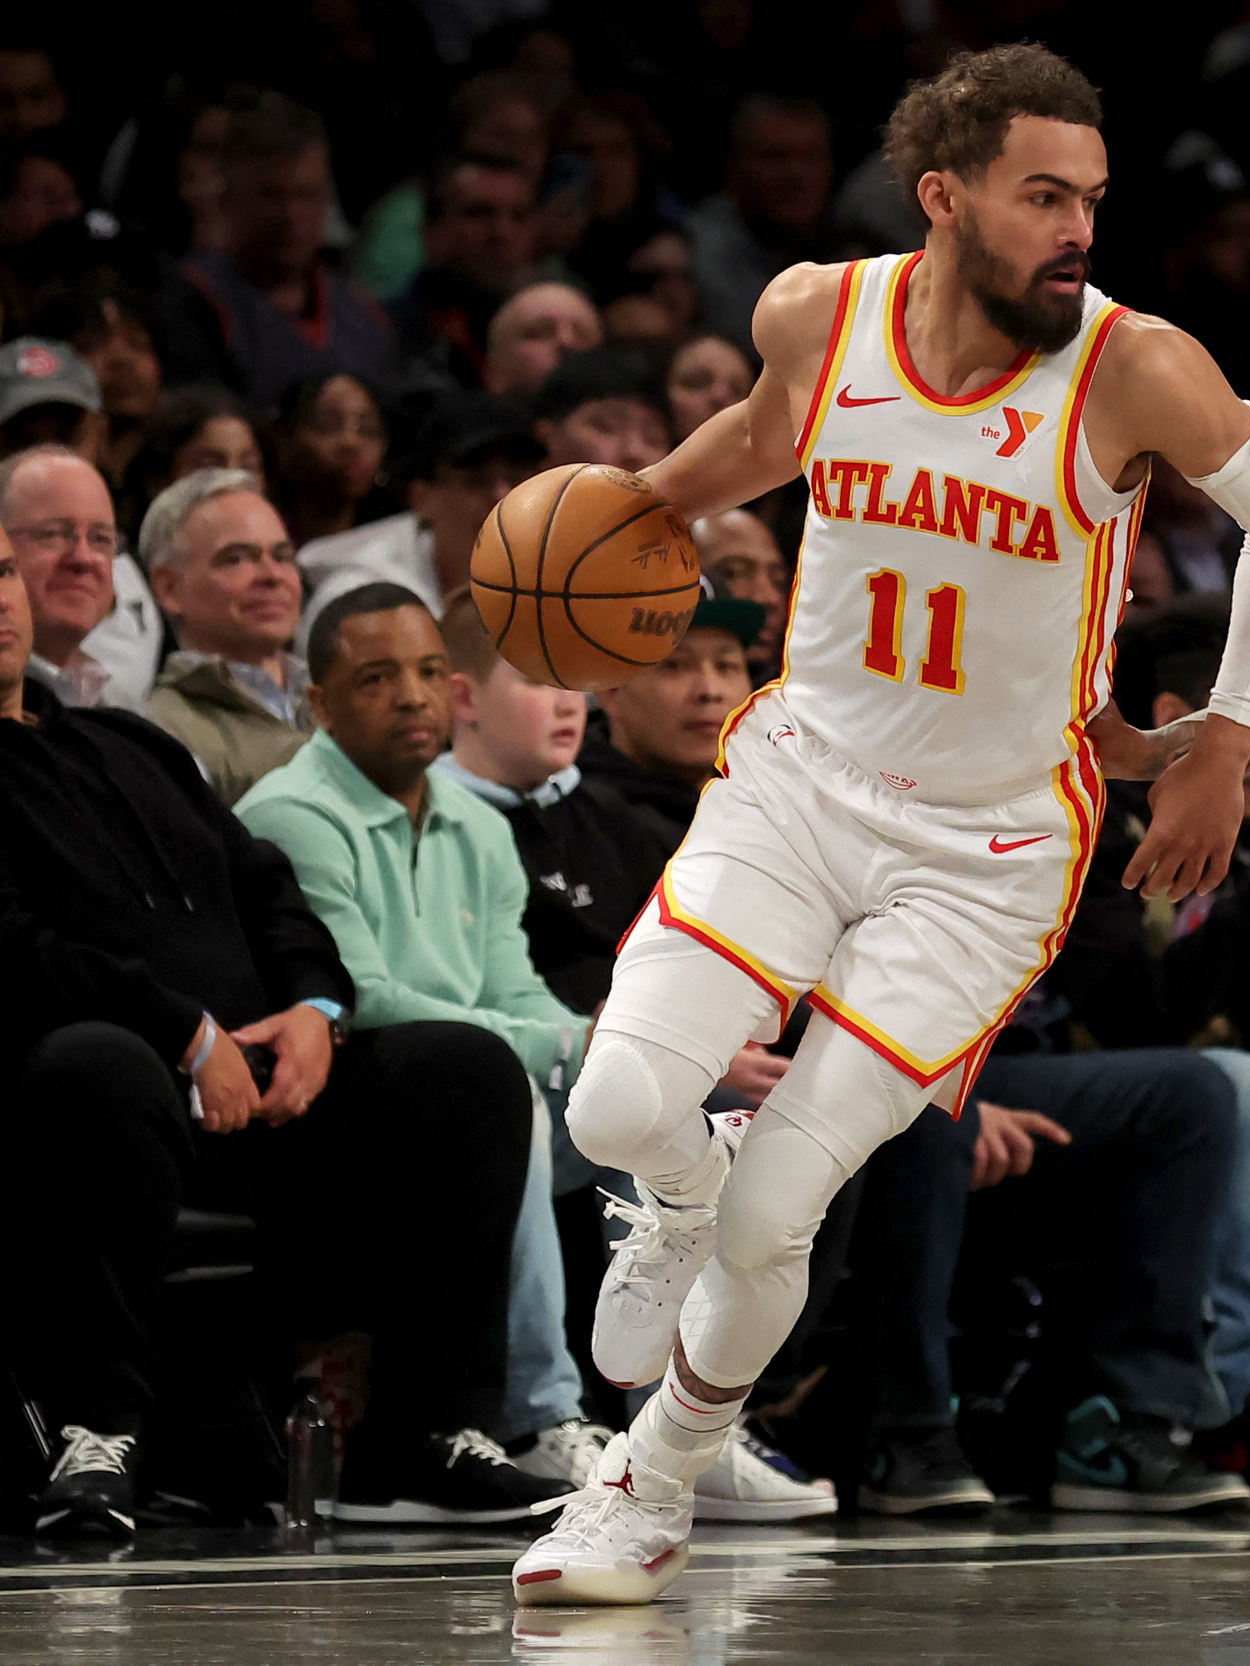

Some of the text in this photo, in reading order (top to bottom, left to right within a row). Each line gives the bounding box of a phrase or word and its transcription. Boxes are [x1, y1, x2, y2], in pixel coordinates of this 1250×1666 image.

[981, 426, 1001, 440] the
[811, 458, 1061, 564] ATLANTA
[863, 567, 966, 696] 11
